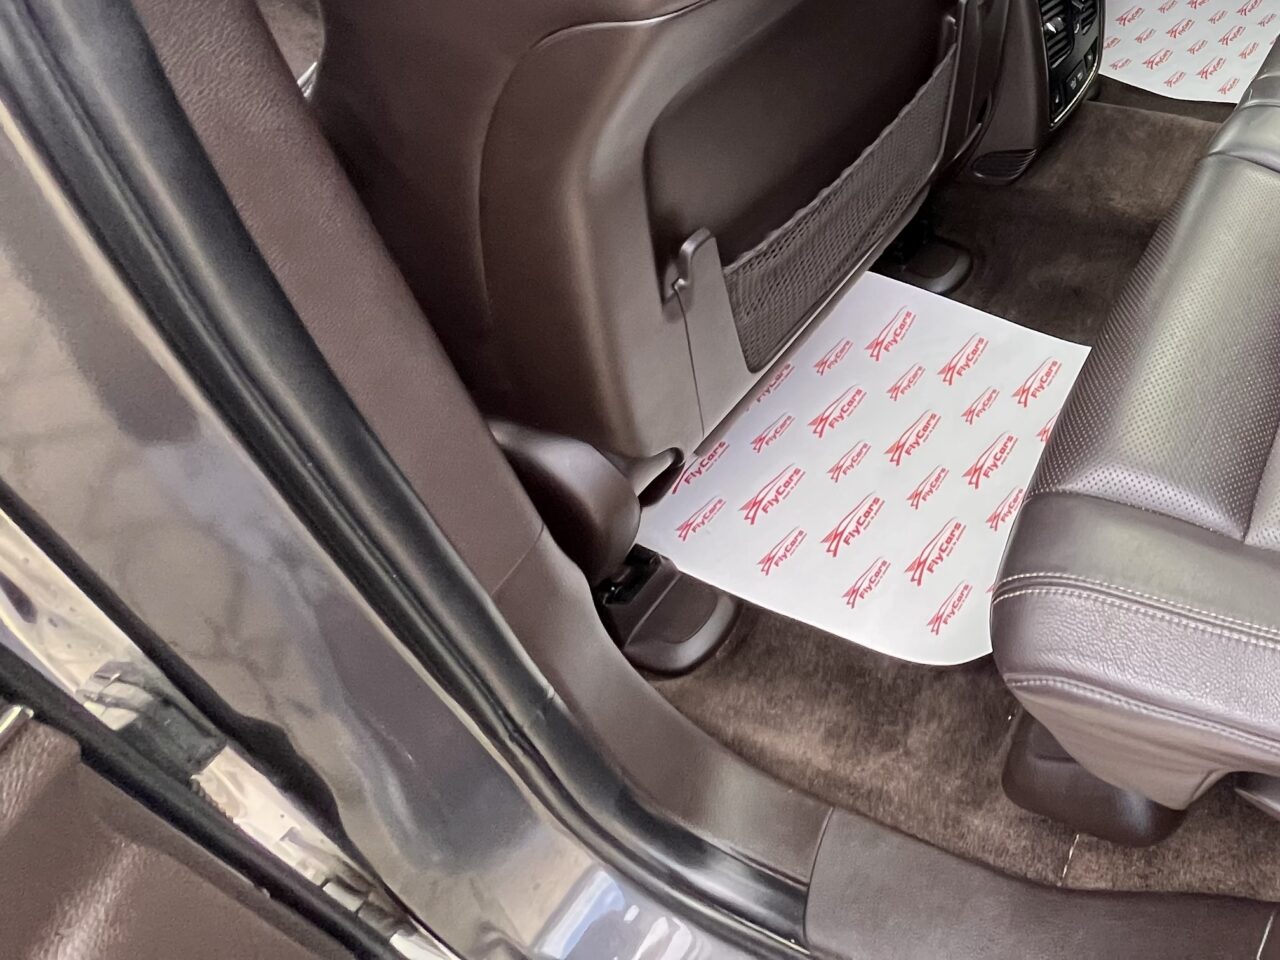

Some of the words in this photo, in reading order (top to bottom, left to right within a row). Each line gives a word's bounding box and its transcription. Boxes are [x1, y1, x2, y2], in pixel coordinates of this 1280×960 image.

[883, 311, 912, 352] FlyCars
[956, 337, 985, 377] FlyCars
[1031, 360, 1058, 399] FlyCars
[828, 388, 862, 429] FlyCars
[905, 413, 937, 456] FlyCars
[684, 441, 726, 484] FlyCars
[983, 435, 1014, 479] FlyCars
[762, 468, 801, 513] FlyCars
[843, 497, 880, 545] FlyCars
[774, 530, 804, 567] FlyCars
[927, 522, 962, 573] FlyCars
[859, 560, 888, 599] FlyCars
[943, 584, 969, 625] FlyCars
